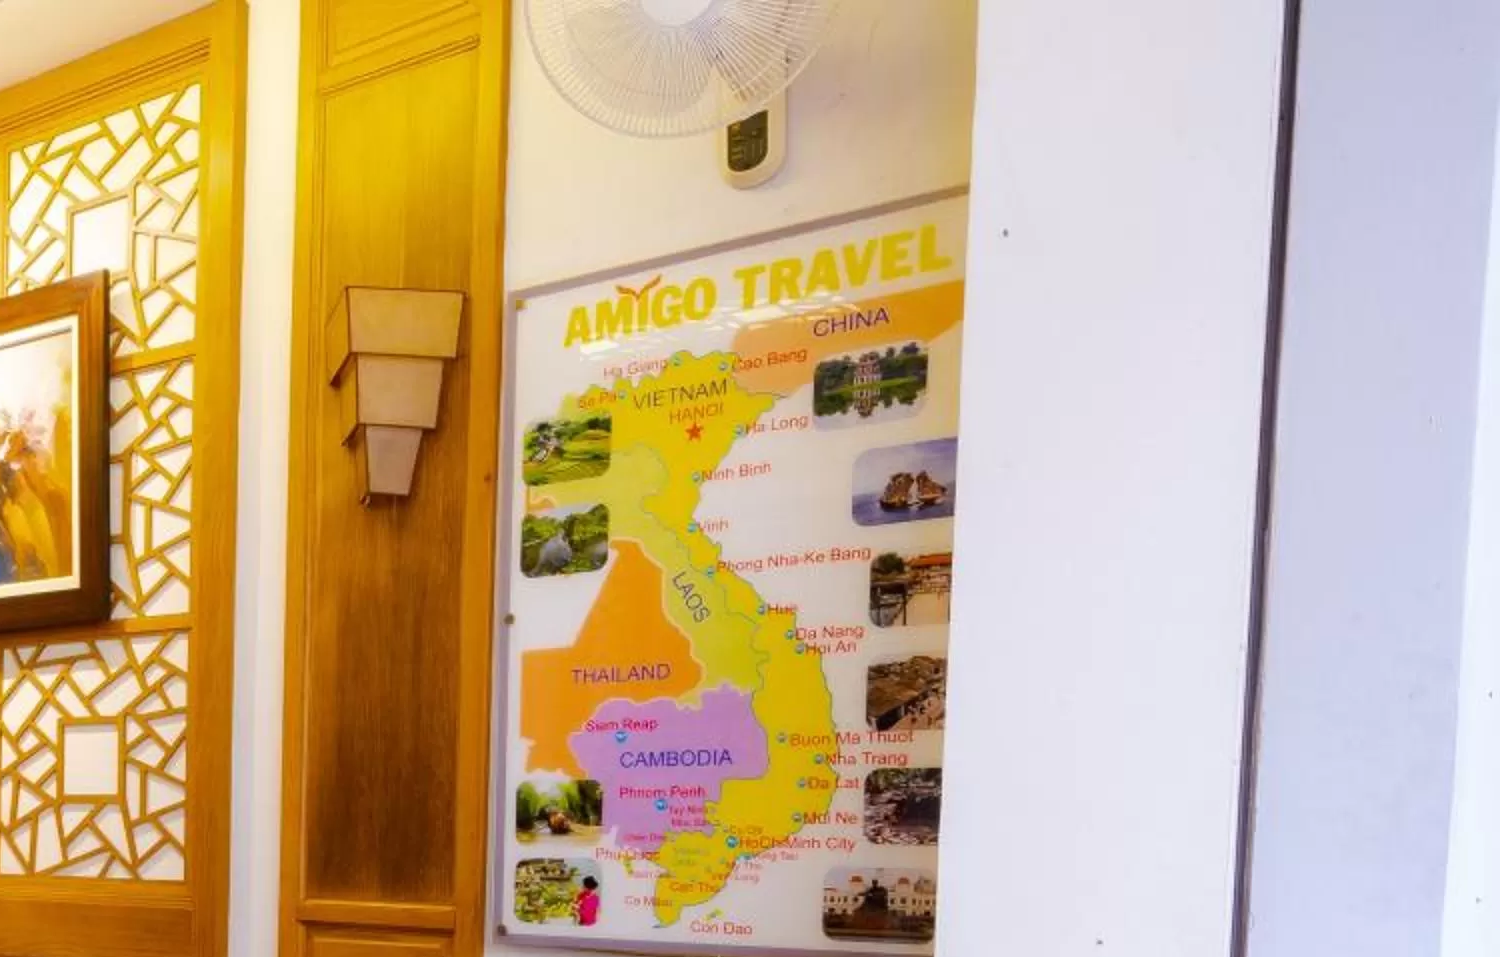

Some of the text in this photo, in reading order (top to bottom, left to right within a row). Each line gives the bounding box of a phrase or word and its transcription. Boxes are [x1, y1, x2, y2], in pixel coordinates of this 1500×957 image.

[564, 224, 952, 347] AMIGO TRAVEL
[813, 307, 890, 337] CHINA
[767, 348, 808, 367] Bang
[632, 378, 728, 410] VIETNAM
[668, 402, 725, 424] HANOI
[771, 415, 809, 431] Long
[701, 462, 772, 482] Ninh Binh
[830, 546, 872, 562] Bang
[672, 571, 710, 623] LAOS
[823, 624, 865, 641] Nang
[836, 641, 857, 653] An
[572, 663, 671, 684] THAILAND
[790, 732, 831, 747] Buon
[866, 729, 914, 743] Thuot
[619, 749, 733, 768] CAMBODIA
[862, 751, 908, 766] Trang
[835, 811, 858, 825] Ne
